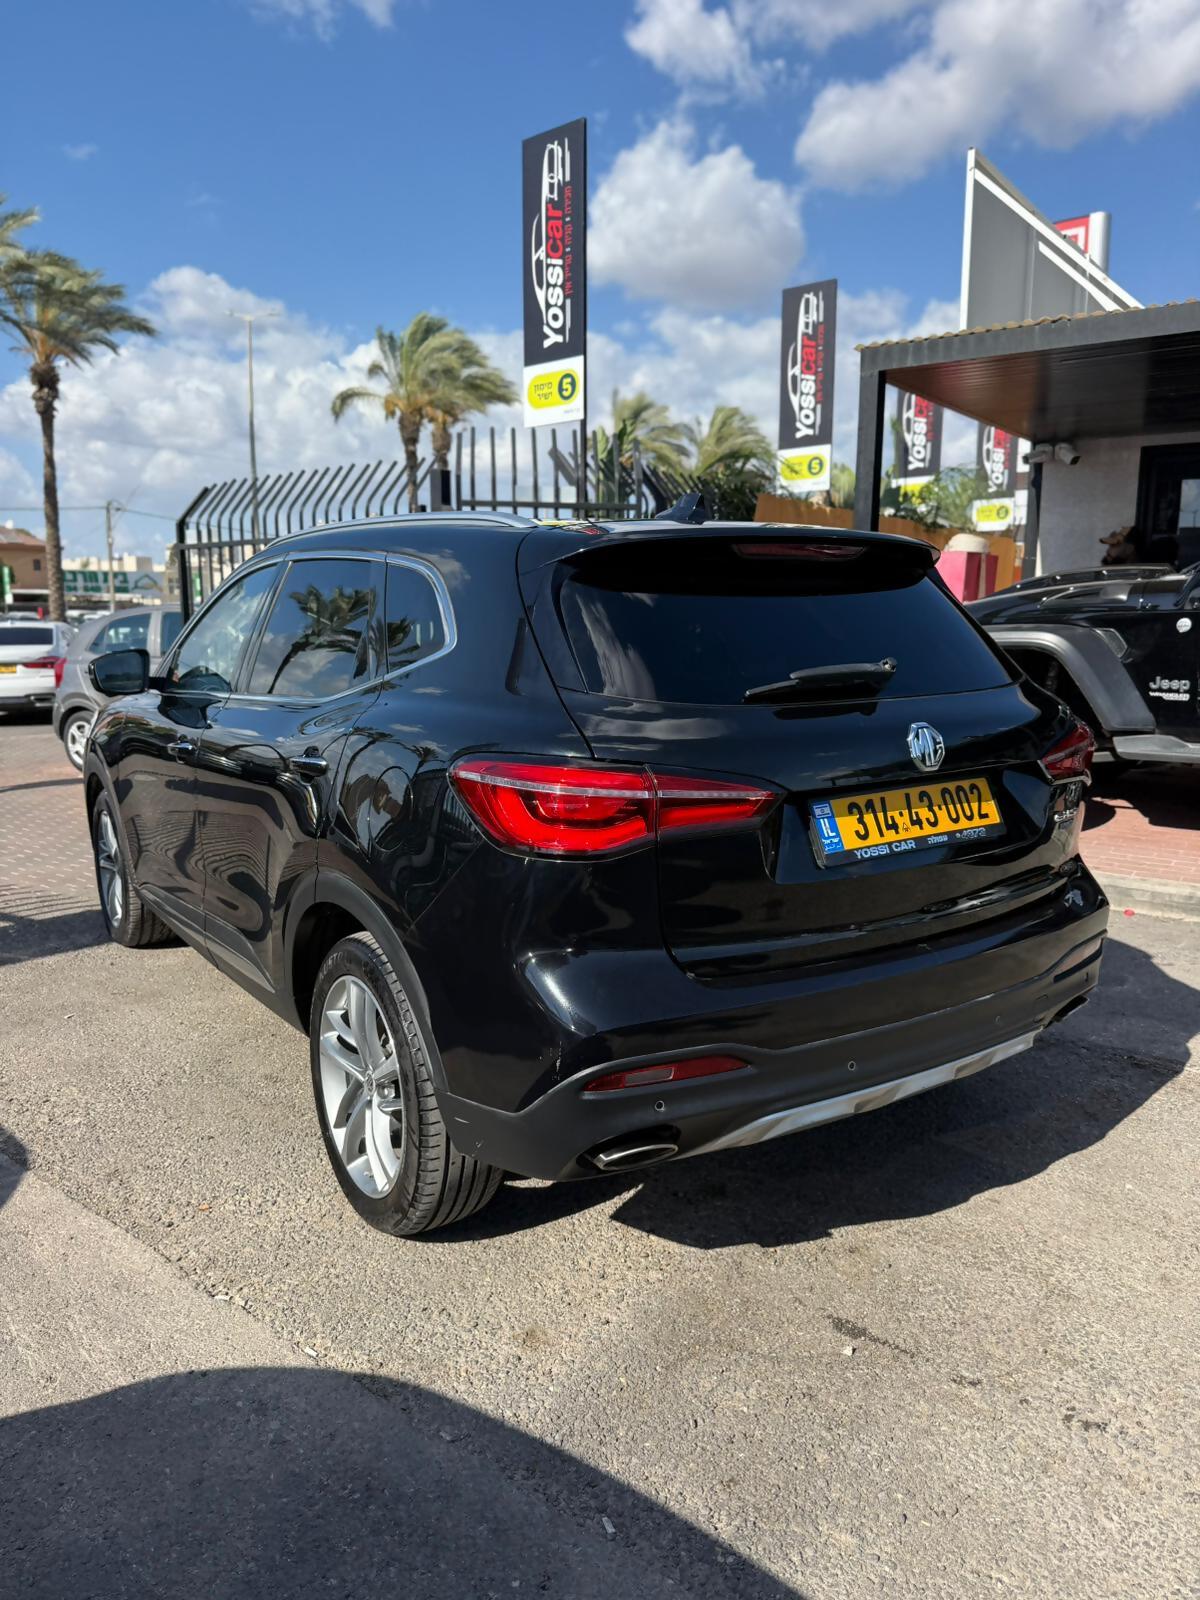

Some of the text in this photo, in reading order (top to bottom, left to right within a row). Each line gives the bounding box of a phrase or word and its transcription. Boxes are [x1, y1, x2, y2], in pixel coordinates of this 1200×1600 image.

[543, 203, 563, 349] Yossicar
[795, 335, 817, 439] Yossicar
[1149, 676, 1190, 693] Jeep
[819, 818, 836, 838] IL
[854, 845, 890, 860] YOSSI
[893, 839, 917, 852] CAR
